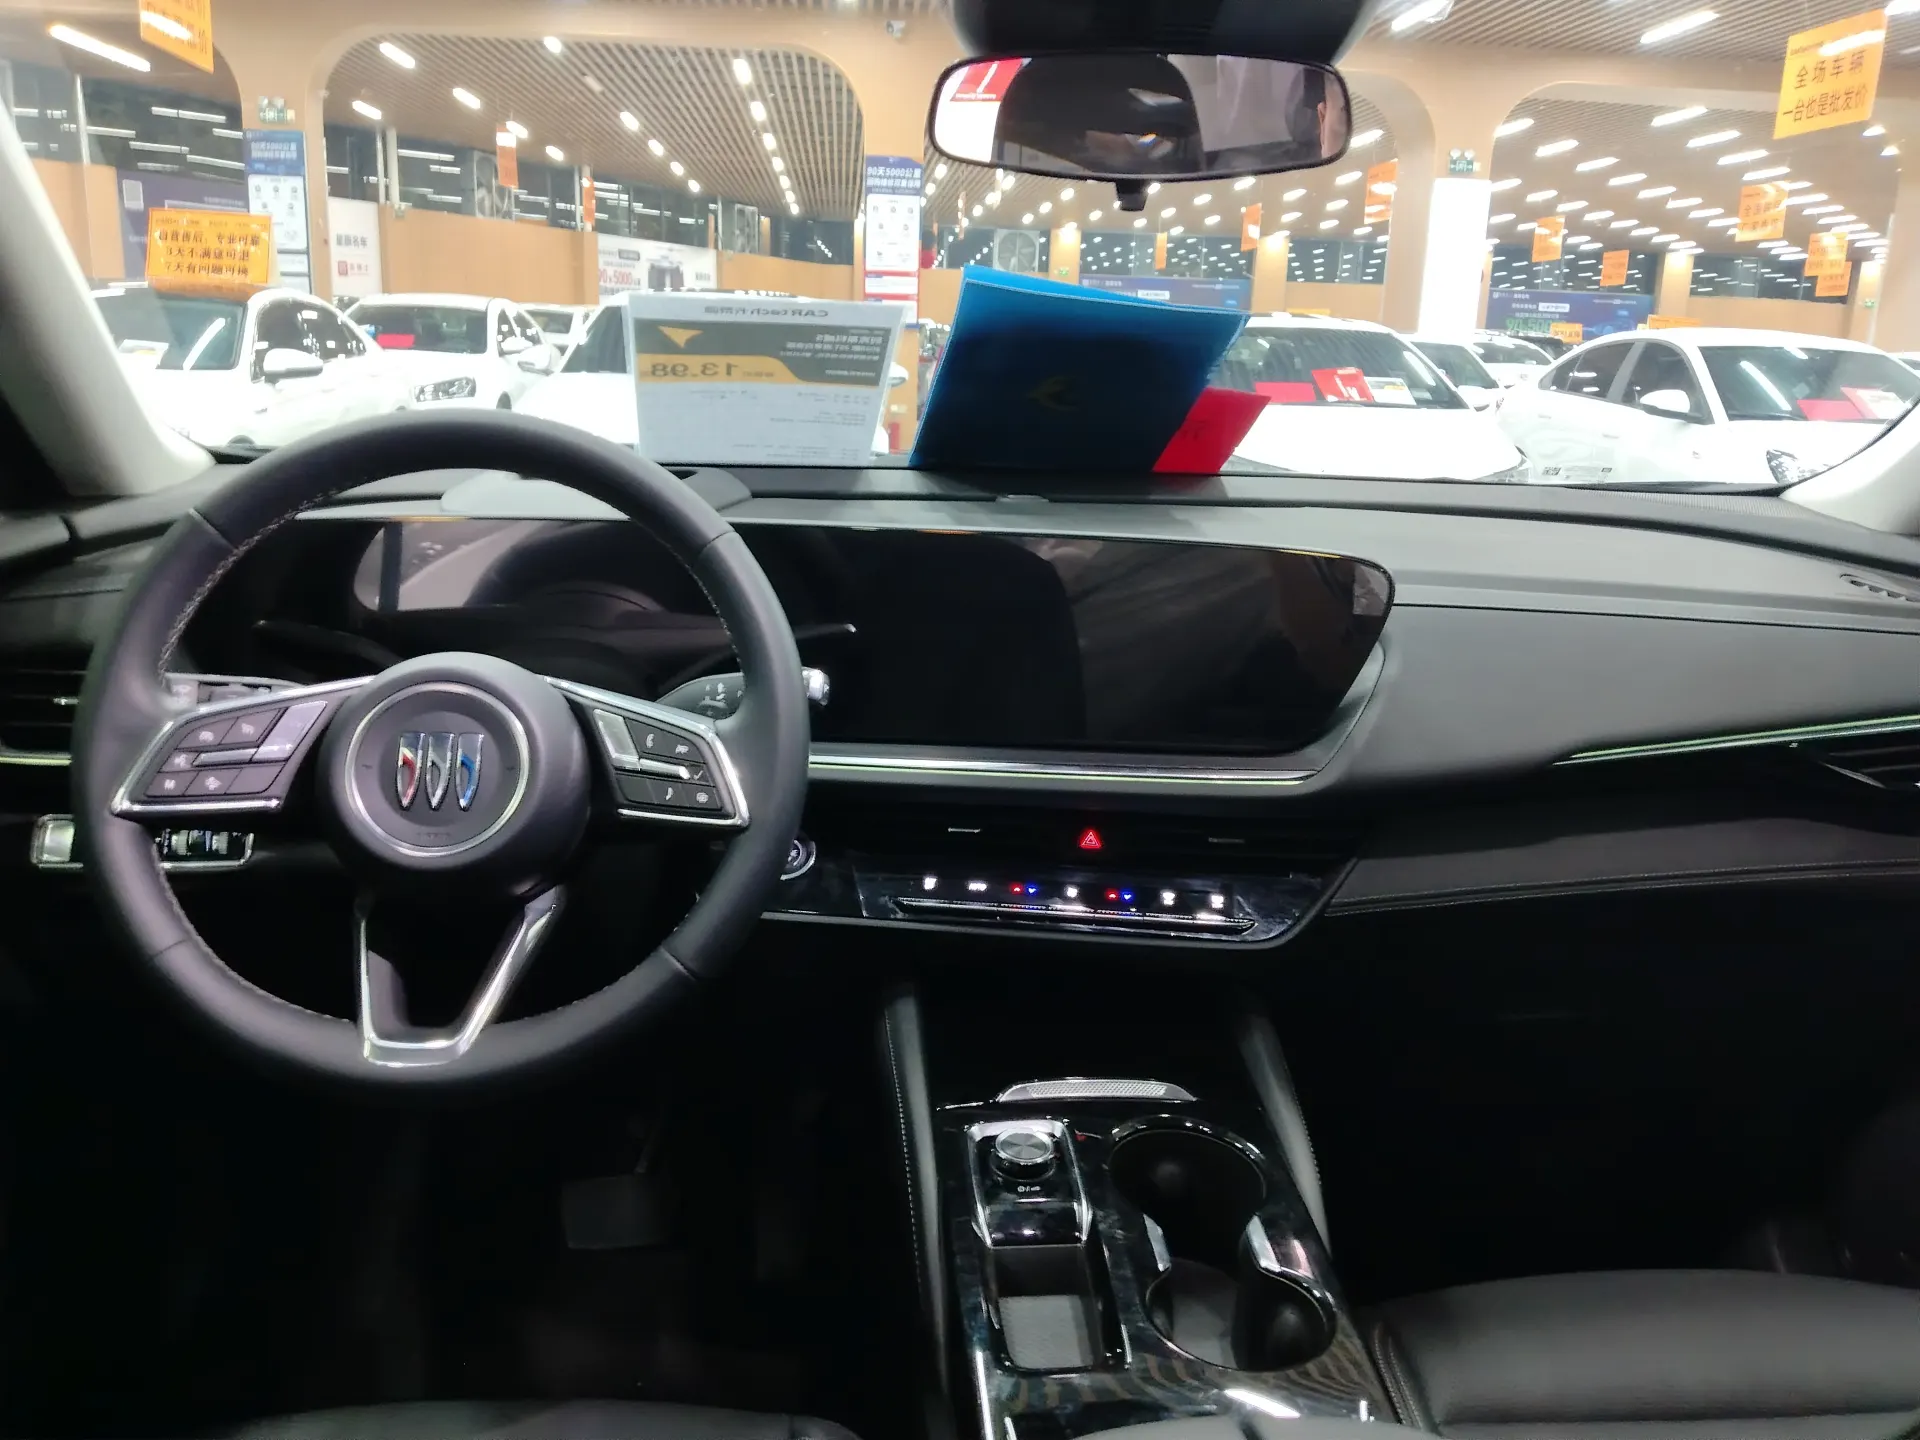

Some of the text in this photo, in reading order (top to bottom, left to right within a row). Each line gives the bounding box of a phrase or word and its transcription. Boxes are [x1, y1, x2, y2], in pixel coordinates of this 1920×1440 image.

[1794, 49, 1867, 90] 全场车辆
[1782, 83, 1868, 122] 一台也是批发价
